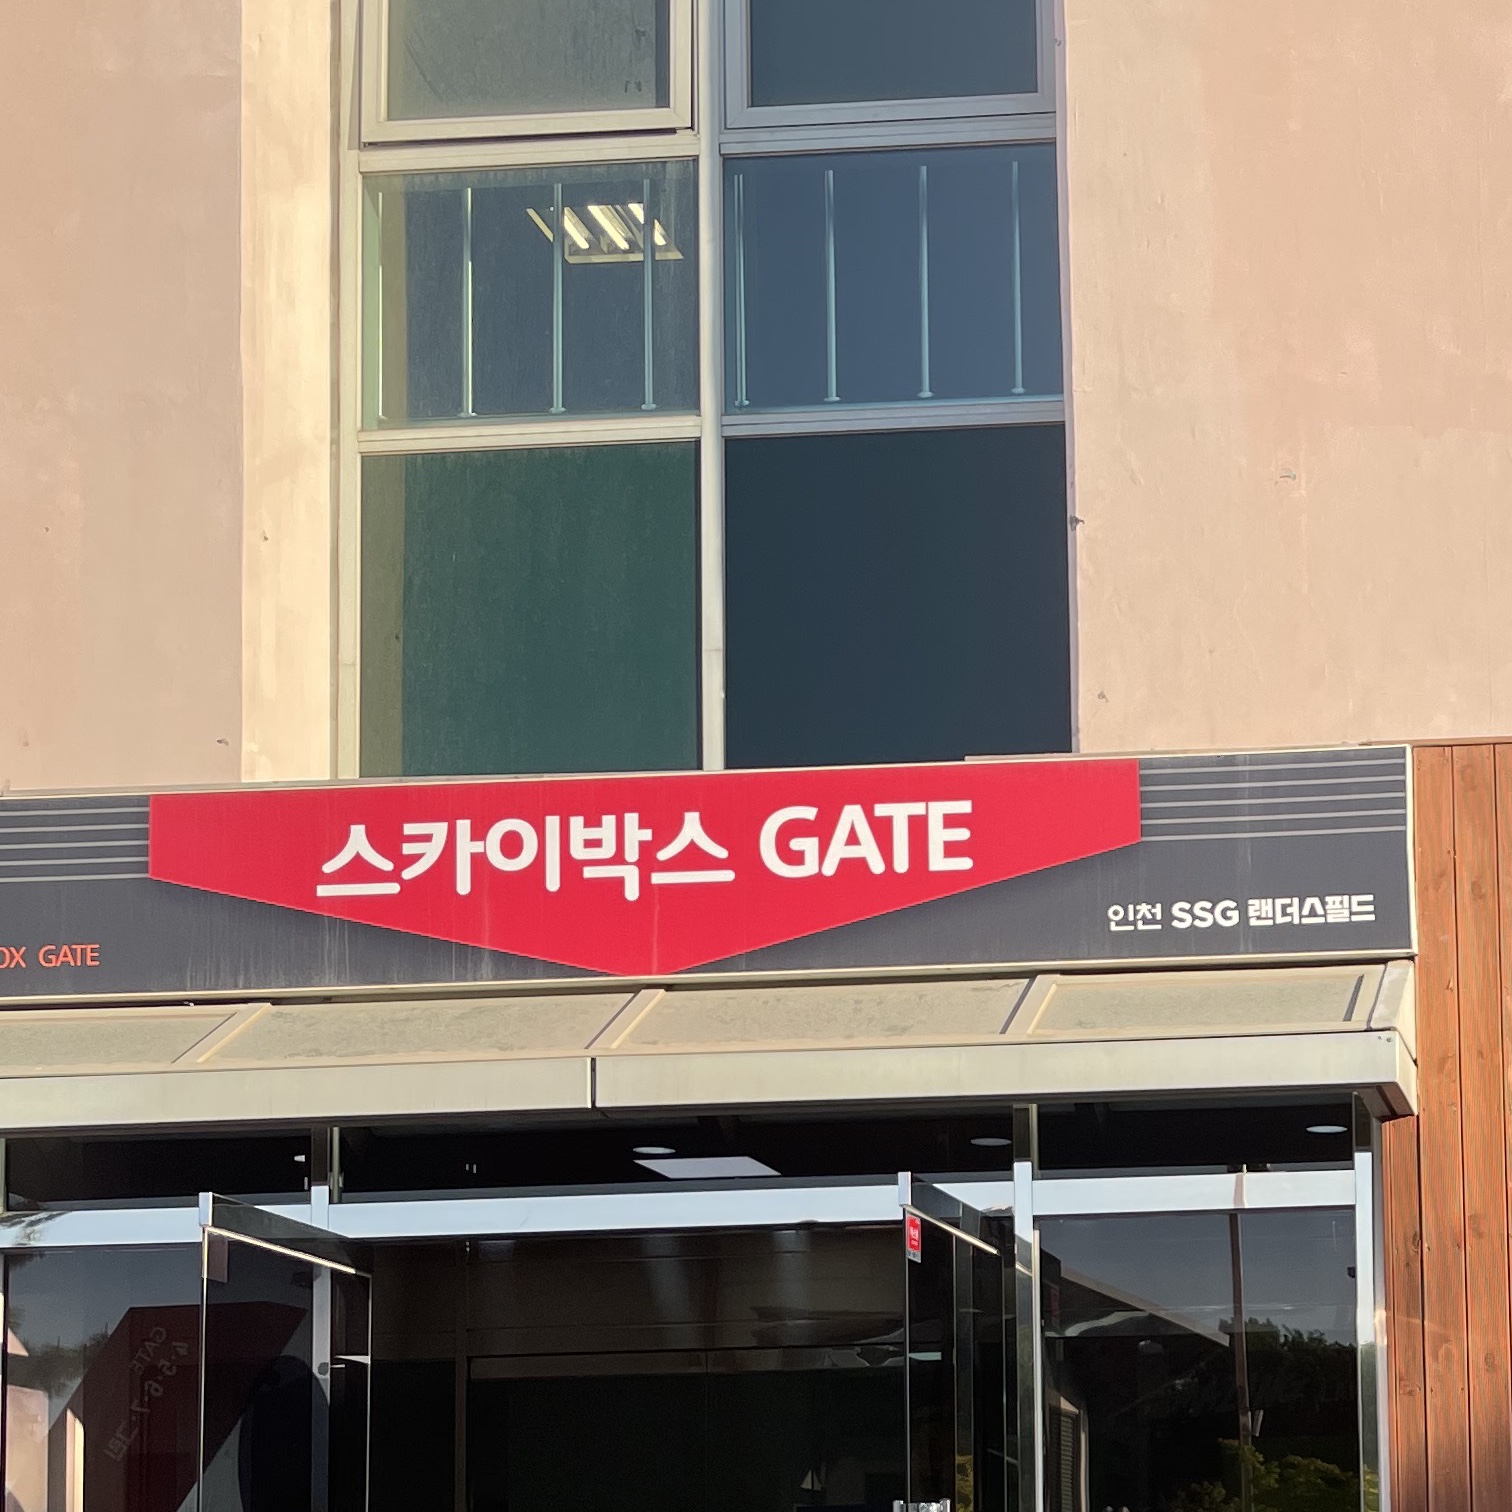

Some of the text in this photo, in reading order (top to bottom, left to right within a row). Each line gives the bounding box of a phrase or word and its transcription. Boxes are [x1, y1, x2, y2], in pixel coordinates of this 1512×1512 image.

[316, 800, 974, 901] 스카이박스 GATE
[1108, 894, 1376, 931] 인천 SSG 랜더스필드
[38, 944, 101, 967] GATE
